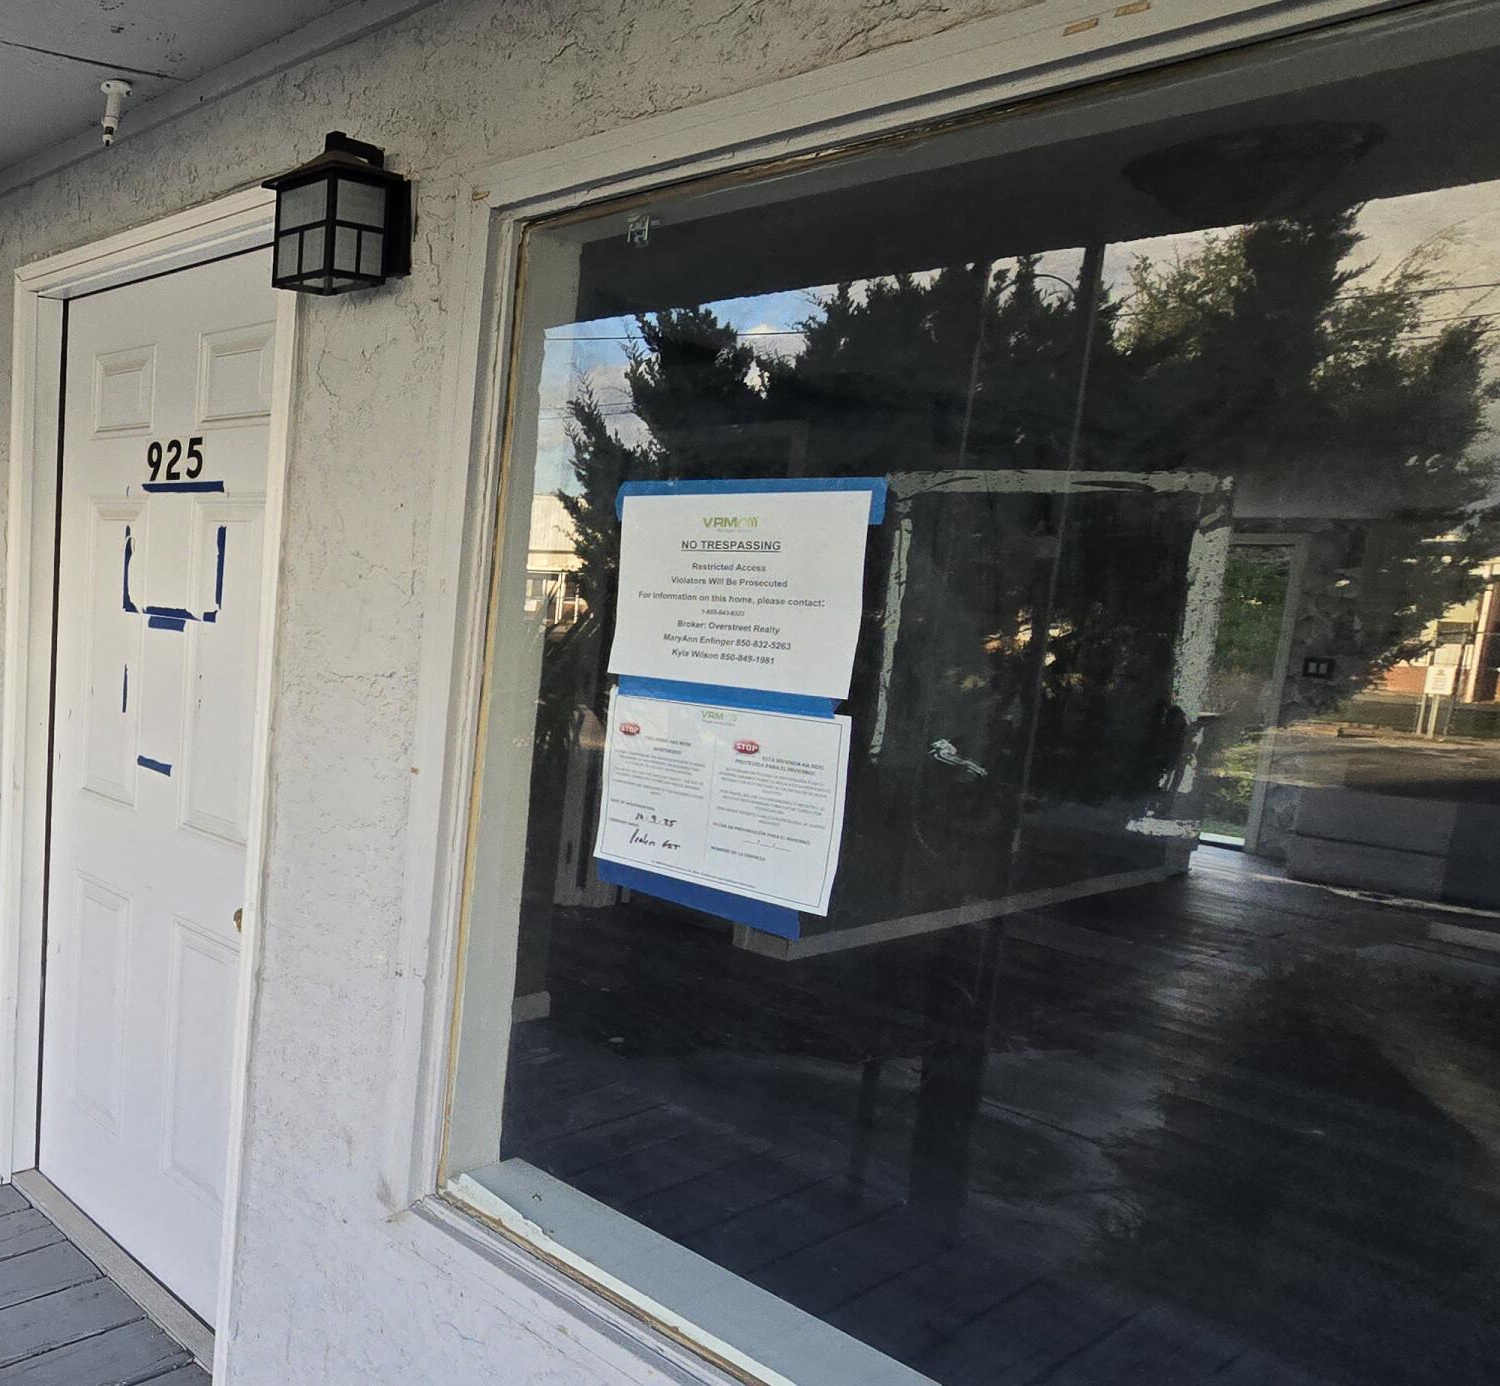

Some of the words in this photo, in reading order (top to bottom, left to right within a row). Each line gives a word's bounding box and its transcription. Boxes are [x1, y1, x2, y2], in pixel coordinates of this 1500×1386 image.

[147, 436, 203, 482] 925
[681, 540, 698, 550] NO
[701, 540, 781, 551] TRESPASSING
[692, 562, 734, 571] Restricted
[735, 563, 766, 572] Access
[671, 575, 706, 584] Violators
[709, 577, 724, 585] Will
[726, 578, 737, 586] Be
[739, 578, 788, 588] Prosecuted
[638, 591, 652, 599] For
[652, 592, 697, 601] information
[711, 594, 727, 602] this
[729, 596, 756, 605] home,
[757, 597, 786, 606] please
[788, 599, 825, 608] contact:
[677, 619, 707, 629] Broker:
[708, 621, 752, 633] Overstreet
[752, 624, 781, 636] Realty
[663, 633, 699, 644] MaryAnn
[691, 649, 719, 660] Wilson
[620, 725, 639, 735] STOP
[735, 742, 758, 752] STOP
